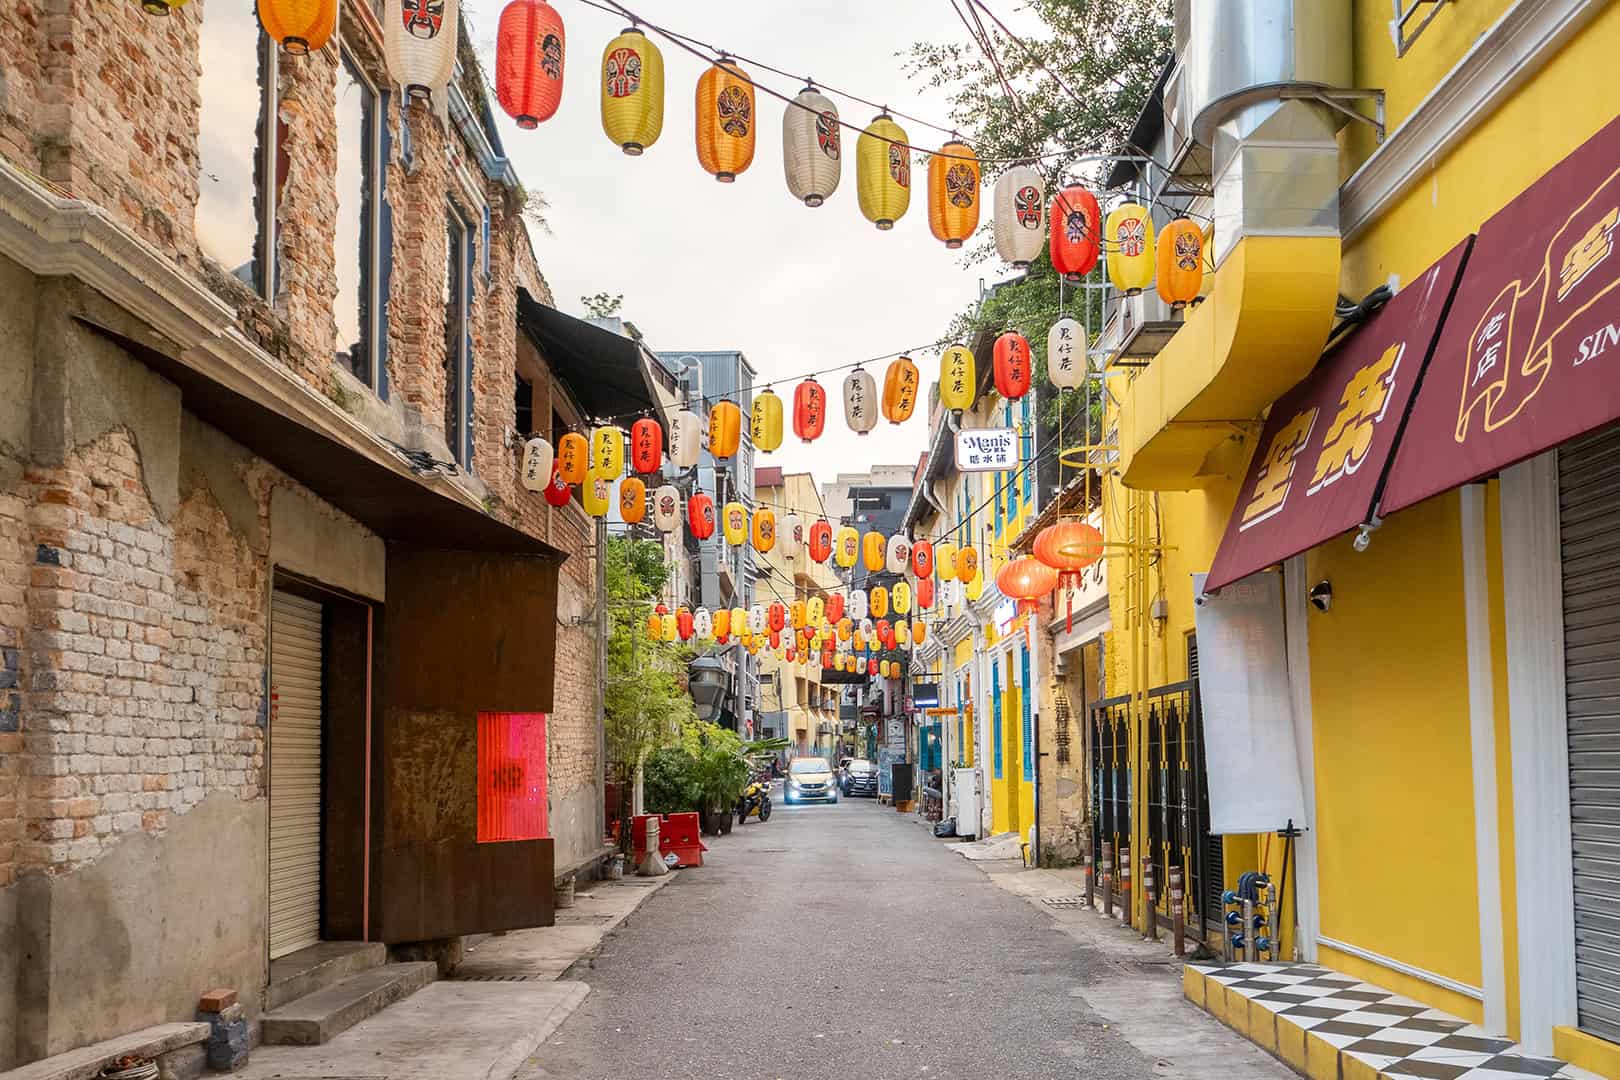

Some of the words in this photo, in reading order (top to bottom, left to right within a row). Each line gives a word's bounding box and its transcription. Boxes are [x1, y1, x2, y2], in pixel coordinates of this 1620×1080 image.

[1058, 327, 1073, 371] 鬼仔巷
[1471, 312, 1507, 387] 老店
[952, 352, 965, 393] 鬼仔巷
[963, 435, 1011, 454] Manis
